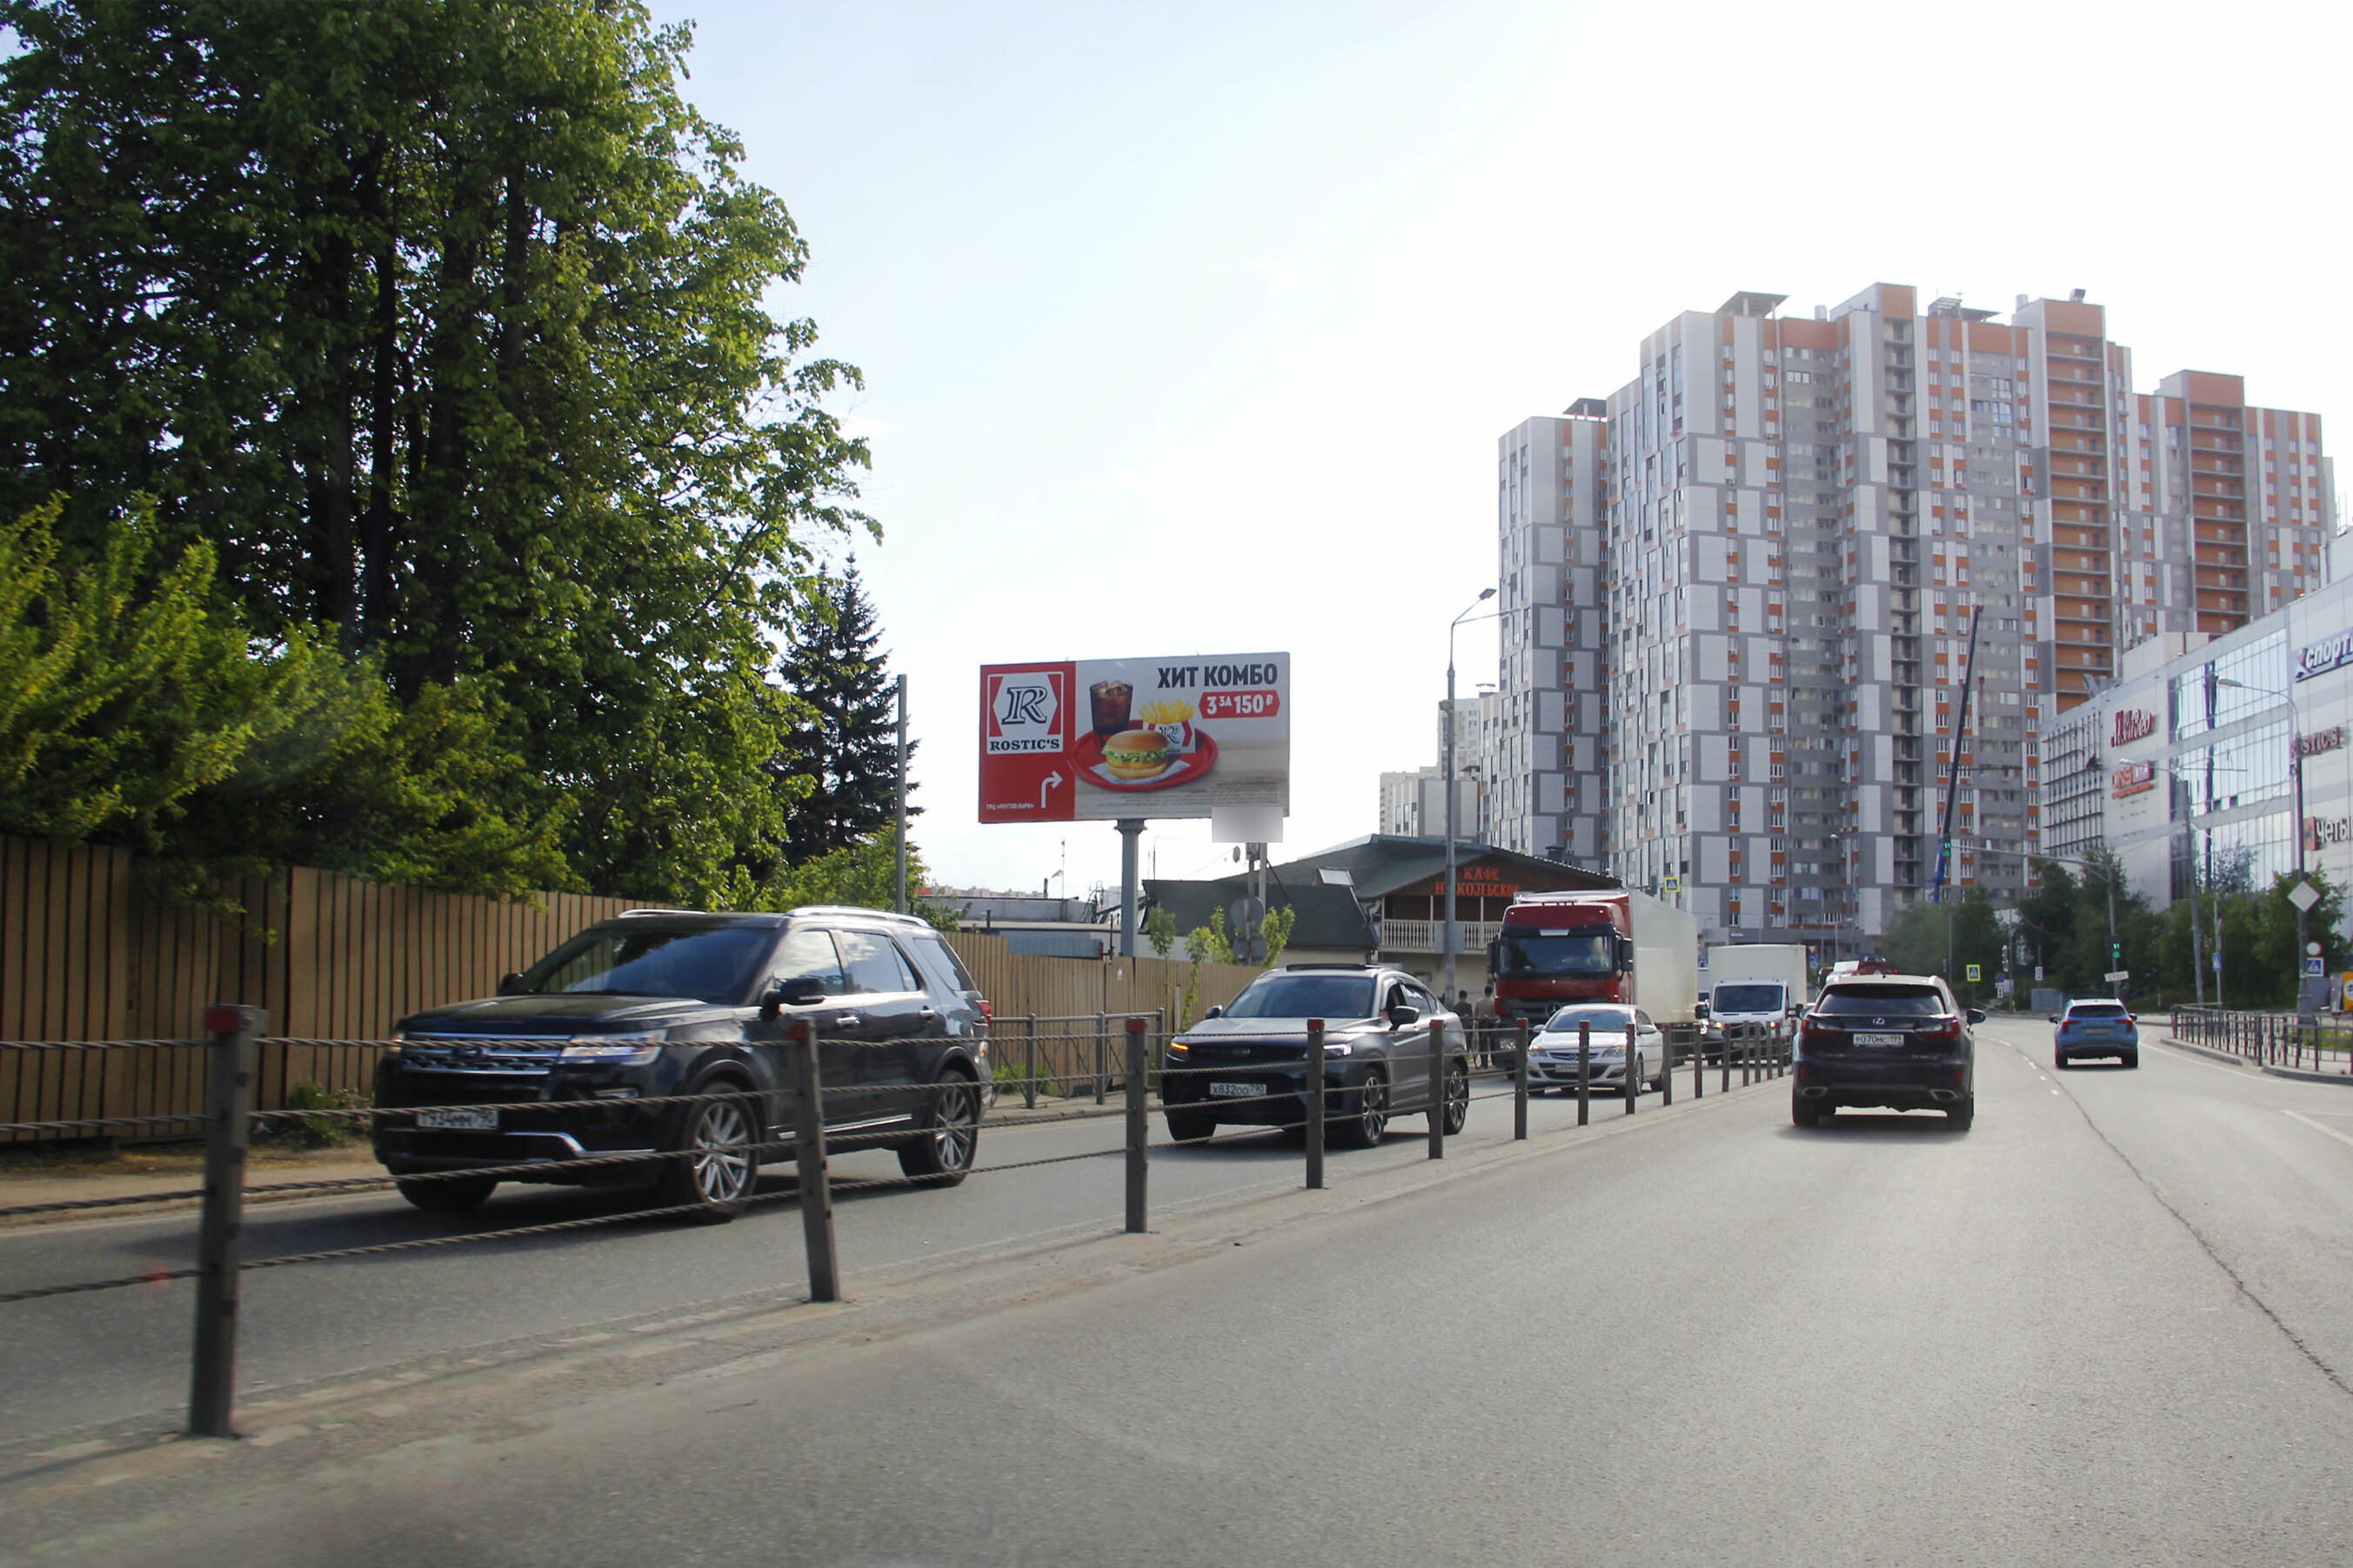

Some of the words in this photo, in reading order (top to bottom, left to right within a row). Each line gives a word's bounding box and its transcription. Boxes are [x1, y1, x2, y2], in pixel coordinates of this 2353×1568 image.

[1157, 666, 1199, 689] ХИТ
[1204, 664, 1278, 687] КОМБО
[1207, 697, 1217, 715] 3
[990, 739, 1060, 751] ROSTIC'S
[1463, 866, 1500, 881] КАФЕ
[1434, 882, 1521, 897] НКОЛЬСКО
